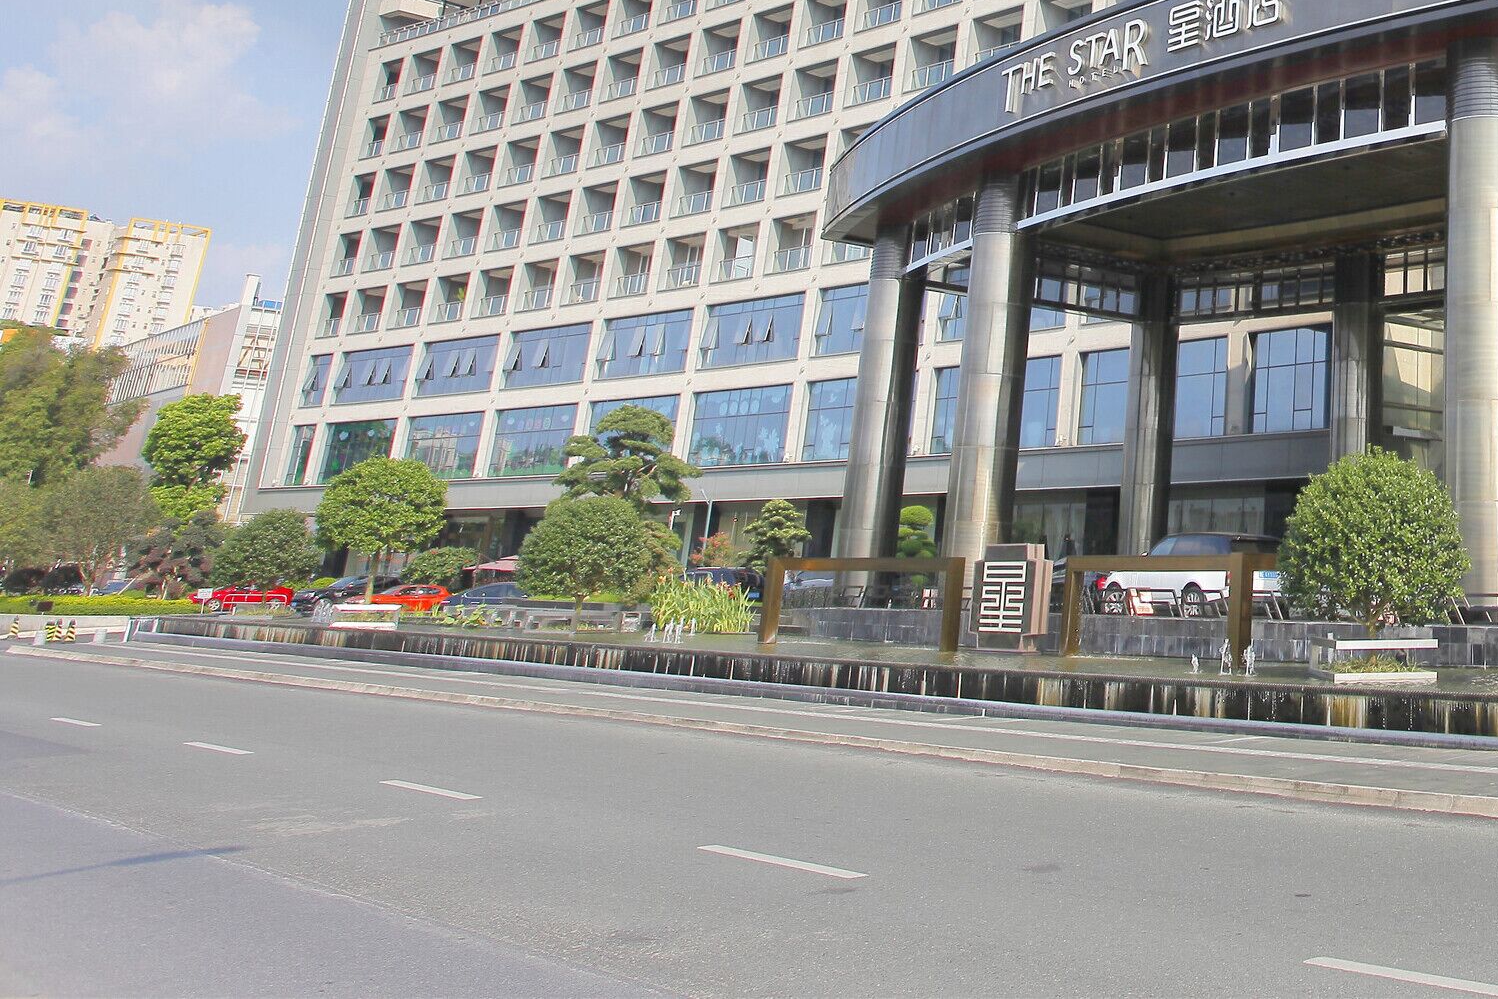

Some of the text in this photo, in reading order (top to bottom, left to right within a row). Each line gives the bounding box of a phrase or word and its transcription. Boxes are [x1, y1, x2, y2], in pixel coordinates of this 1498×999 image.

[1001, 19, 1149, 112] THE STAR
[1068, 64, 1122, 88] HOTEL
